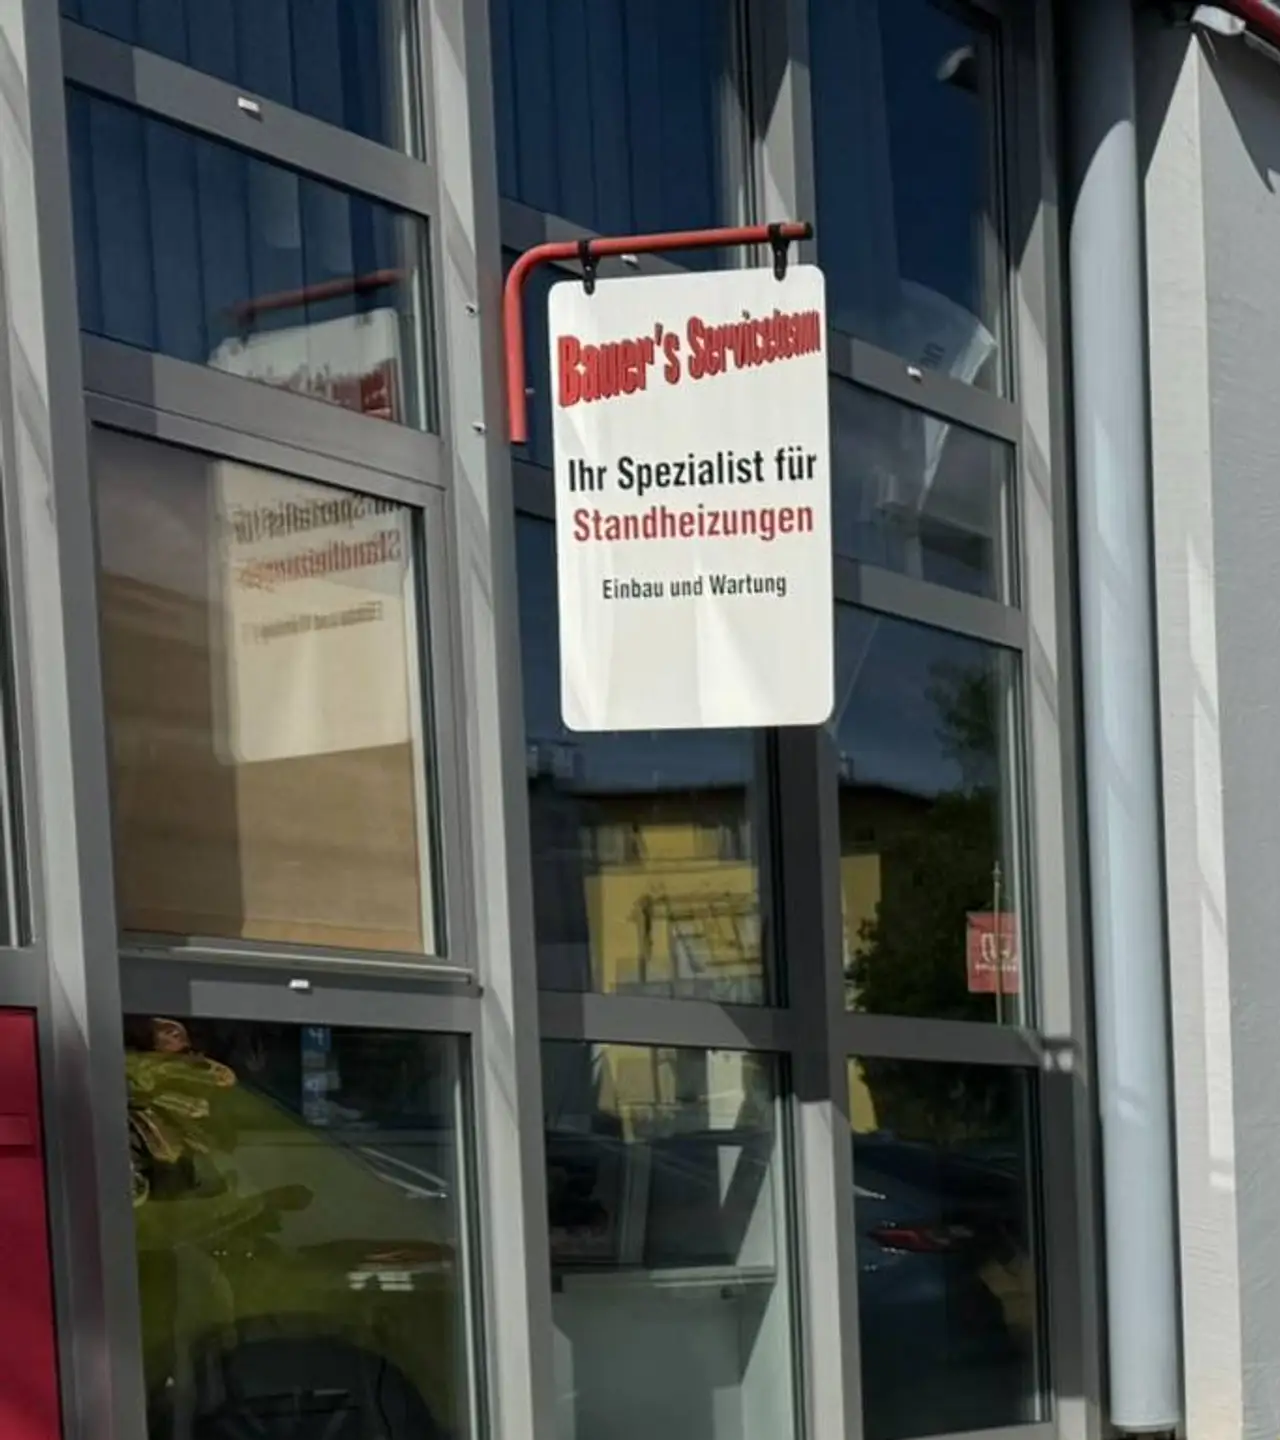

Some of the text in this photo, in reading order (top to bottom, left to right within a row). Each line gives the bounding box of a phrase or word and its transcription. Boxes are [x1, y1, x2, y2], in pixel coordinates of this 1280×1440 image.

[557, 322, 681, 408] Bauer's
[568, 445, 818, 497] Ihr Spezialist für
[572, 503, 814, 542] Standheizungen
[602, 574, 787, 600] Einbau und Wartung
